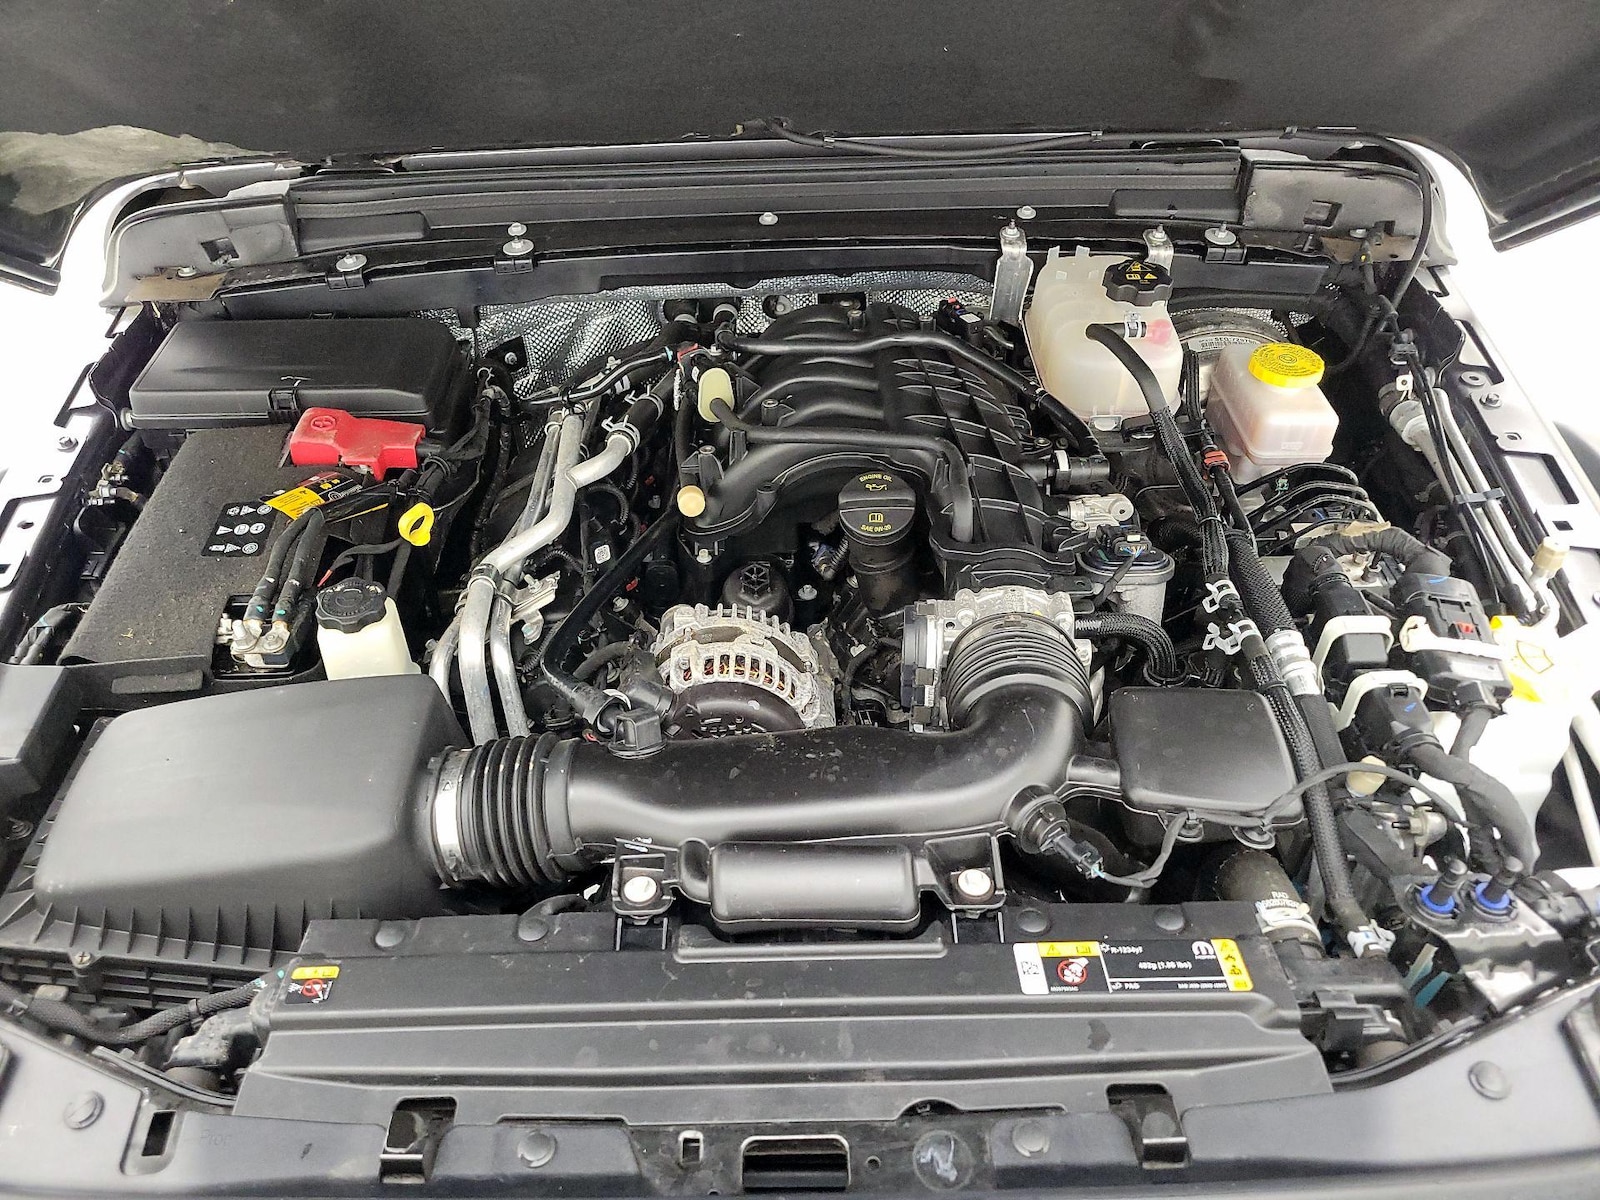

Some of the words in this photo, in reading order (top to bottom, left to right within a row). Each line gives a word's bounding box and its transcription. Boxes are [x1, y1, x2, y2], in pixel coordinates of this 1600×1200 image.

[859, 474, 882, 482] ENGINE
[883, 474, 893, 482] OIL
[860, 524, 874, 532] SAE
